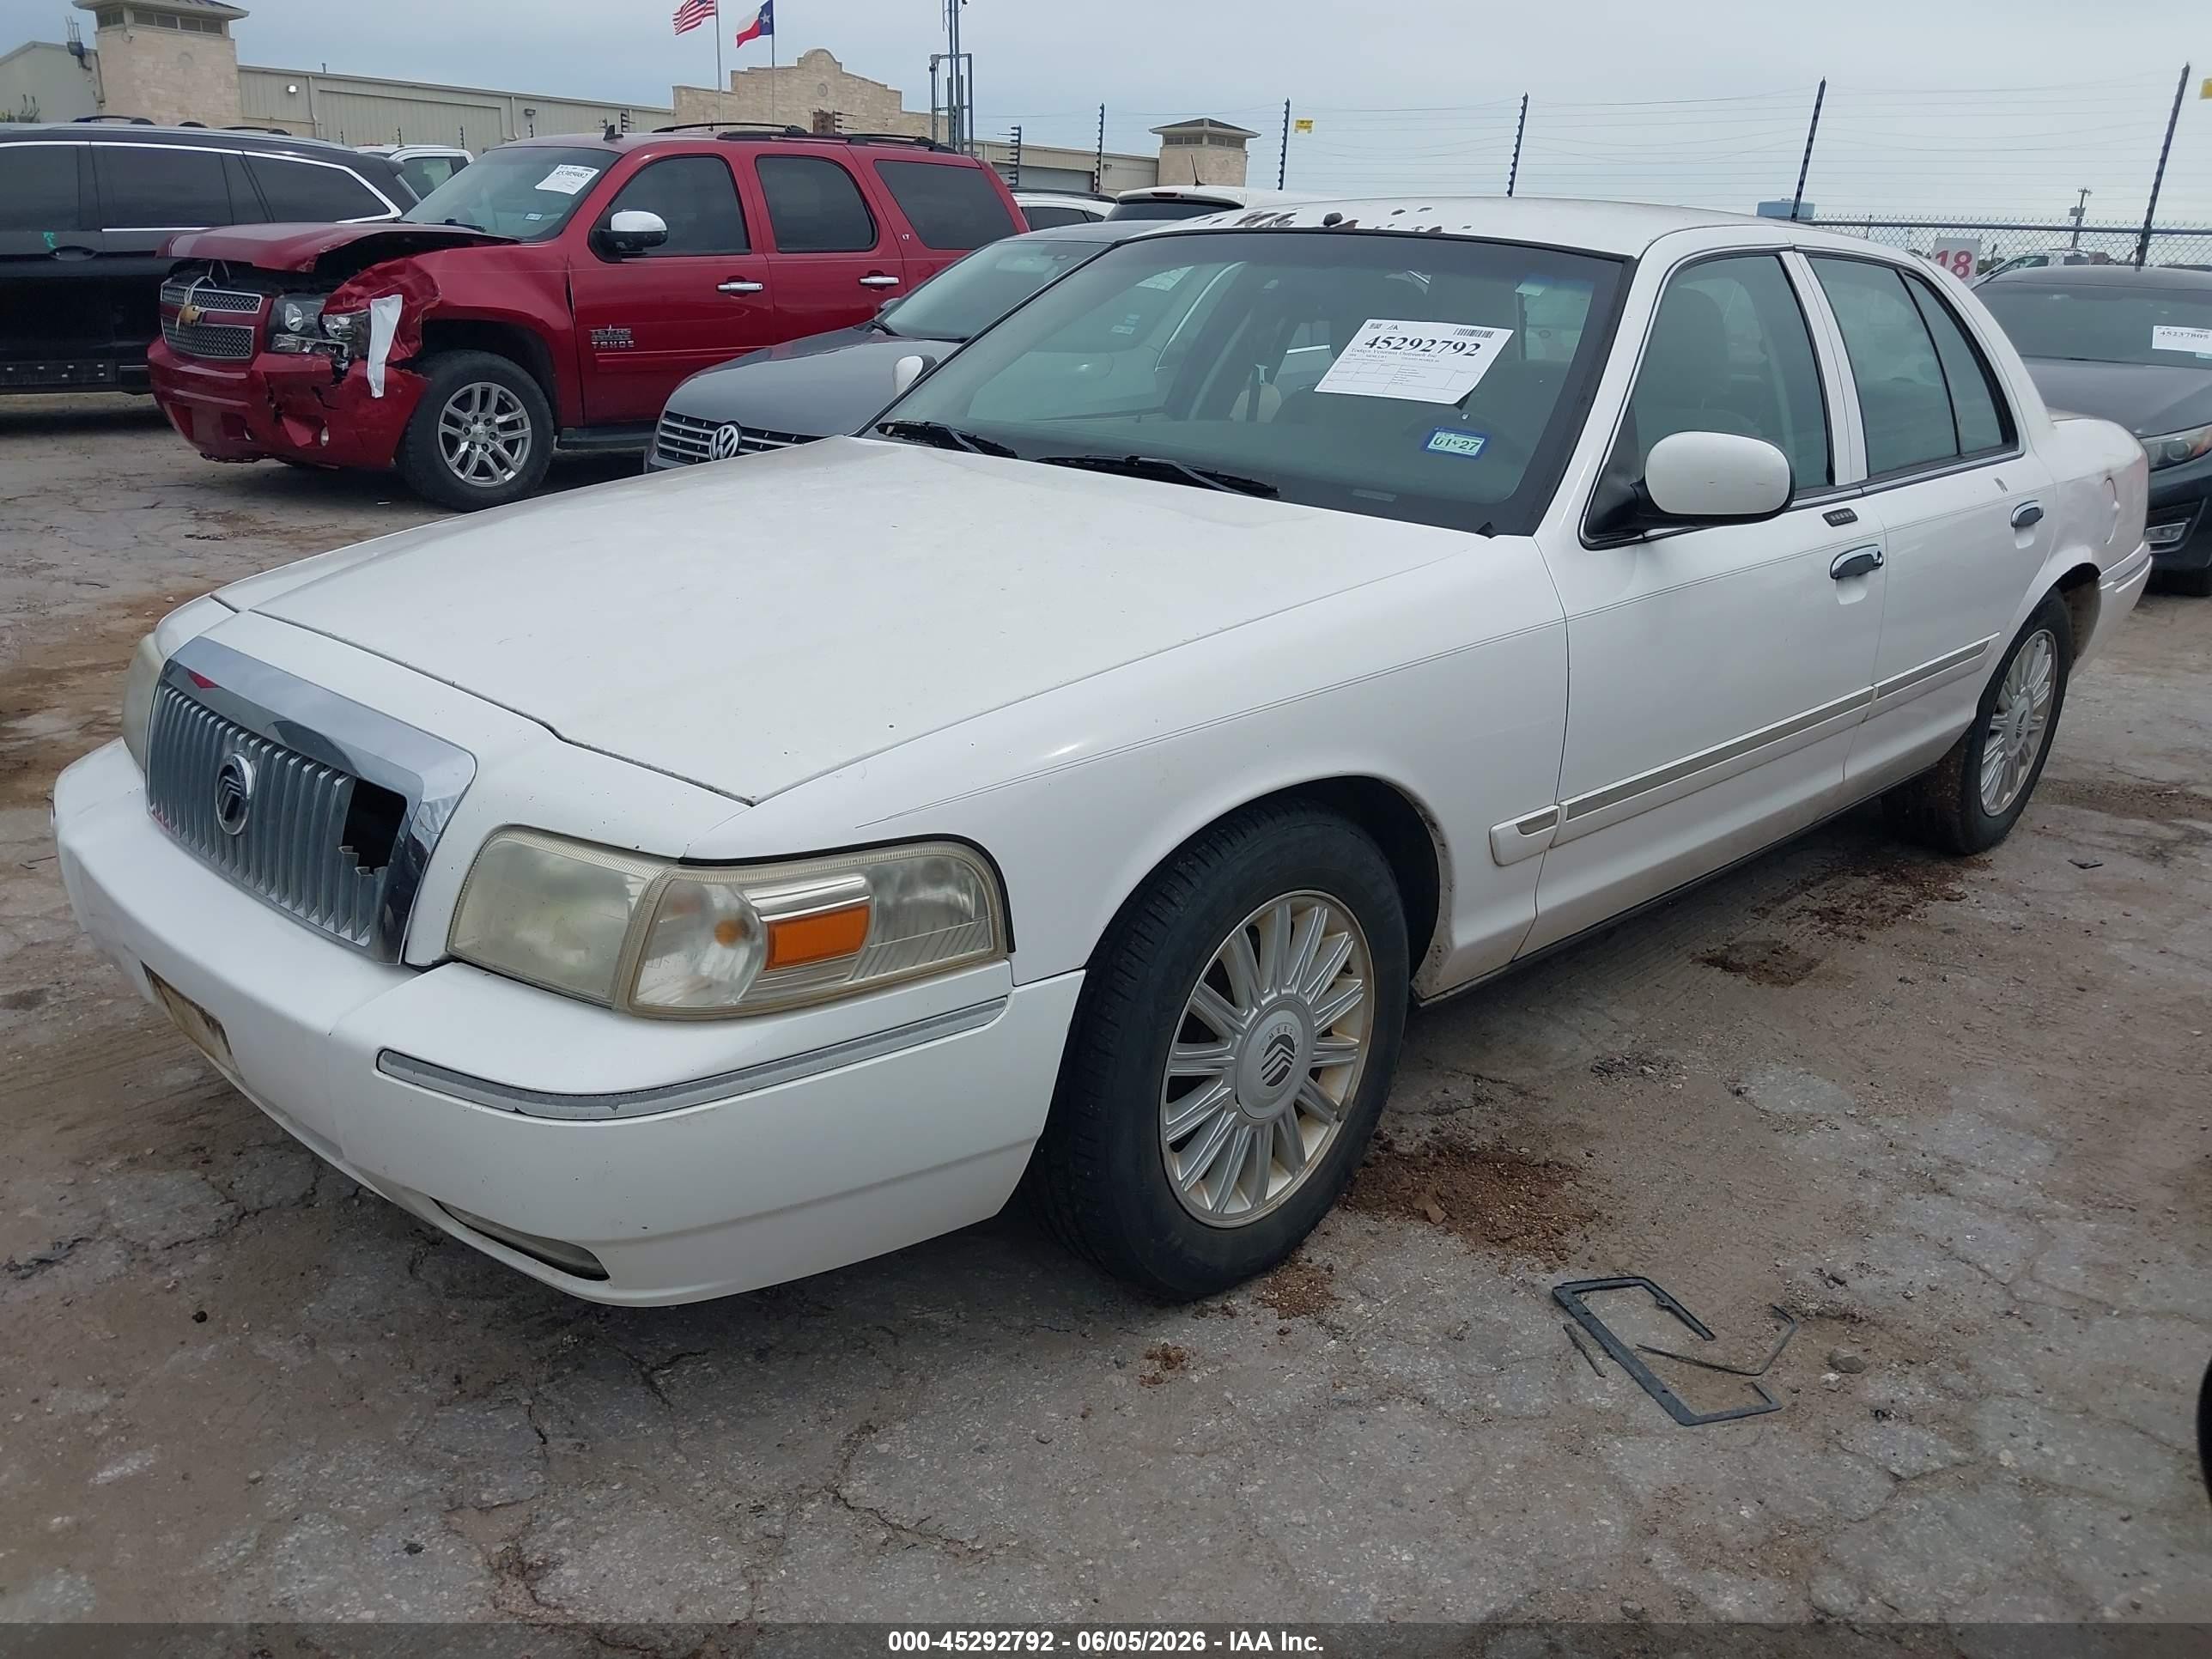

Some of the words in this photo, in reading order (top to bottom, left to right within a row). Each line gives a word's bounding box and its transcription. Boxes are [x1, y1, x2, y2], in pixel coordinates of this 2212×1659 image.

[1936, 251, 1972, 280] 18
[591, 340, 635, 349] TAHOE
[1364, 336, 1481, 357] 45292792
